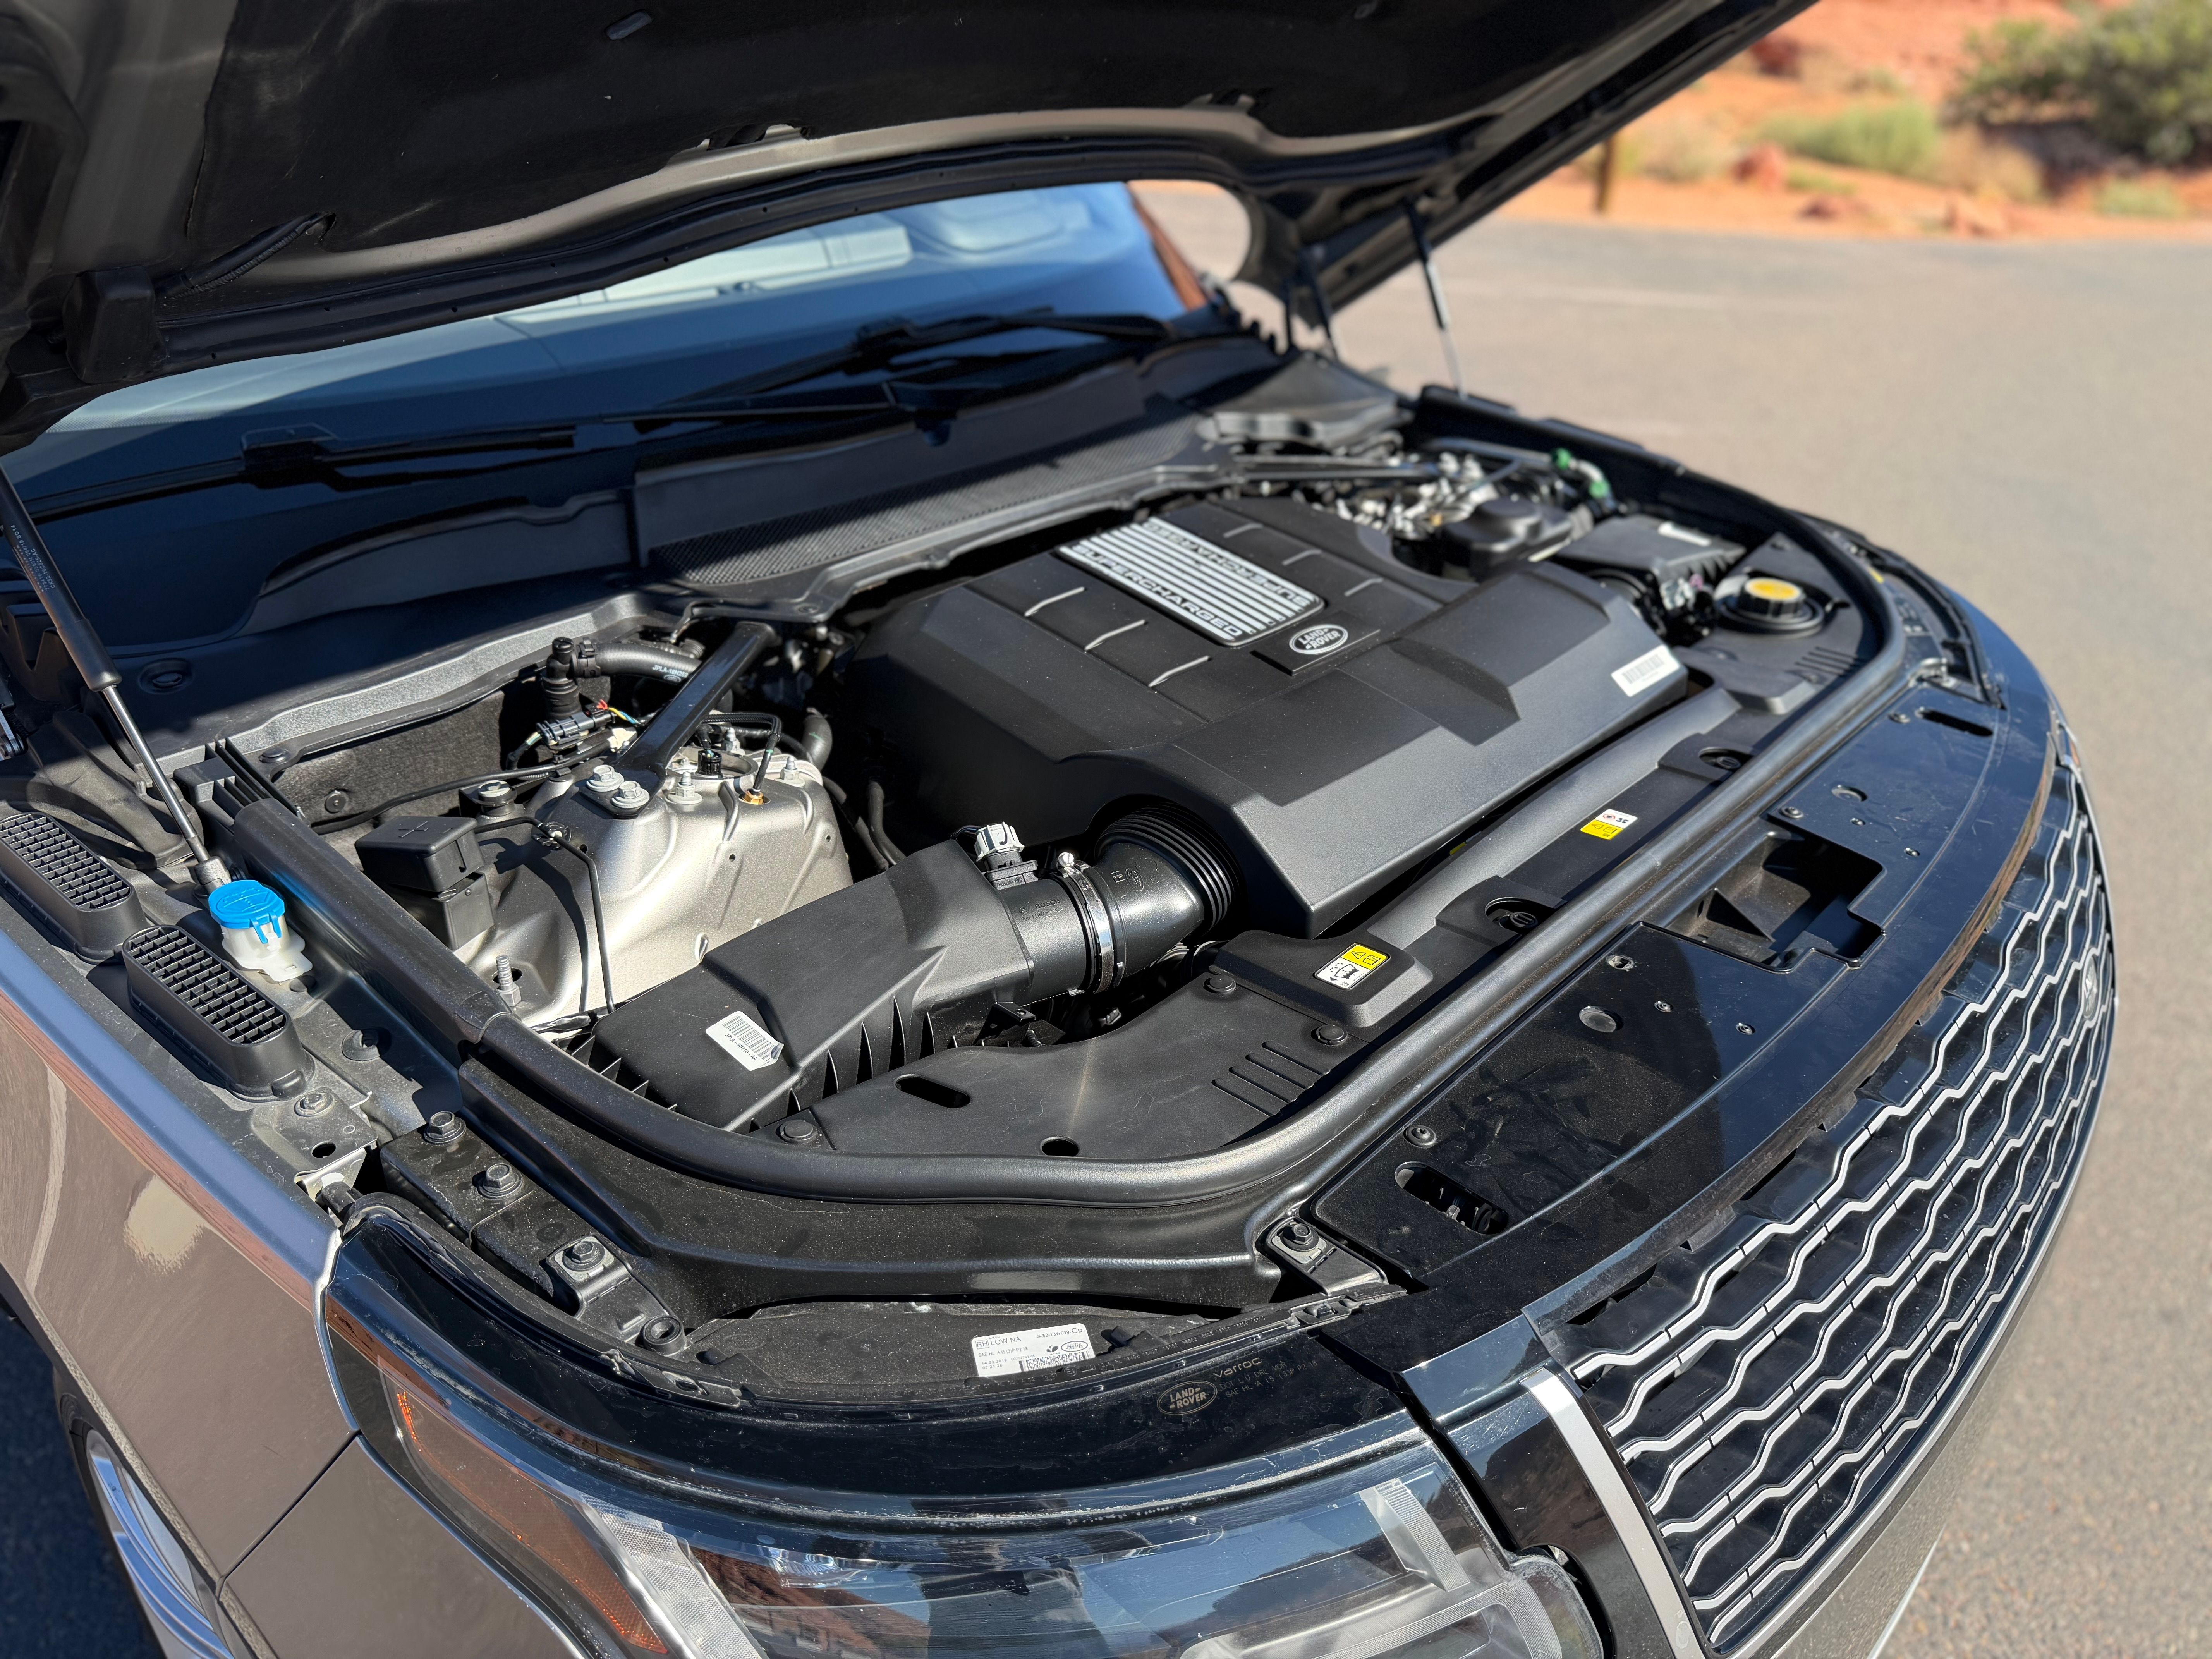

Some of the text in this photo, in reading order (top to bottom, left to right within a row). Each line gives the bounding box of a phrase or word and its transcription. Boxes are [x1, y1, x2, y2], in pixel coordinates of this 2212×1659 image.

[1143, 521, 1310, 607] SUPERCHARGED
[1072, 545, 1242, 637] SUPERCHARGED
[1298, 630, 1325, 644] LAND
[1309, 630, 1341, 648] ROVER
[1035, 899, 1060, 909] BOSCH
[990, 1337, 1008, 1346] LOW
[1212, 1357, 1262, 1378] varroc
[1220, 1380, 1235, 1391] DOT
[1226, 1388, 1240, 1398] SAE
[1242, 1384, 1253, 1392] HL
[1297, 1364, 1307, 1372] P2
[1170, 1387, 1195, 1402] LAND
[1177, 1391, 1207, 1409] ROVER
